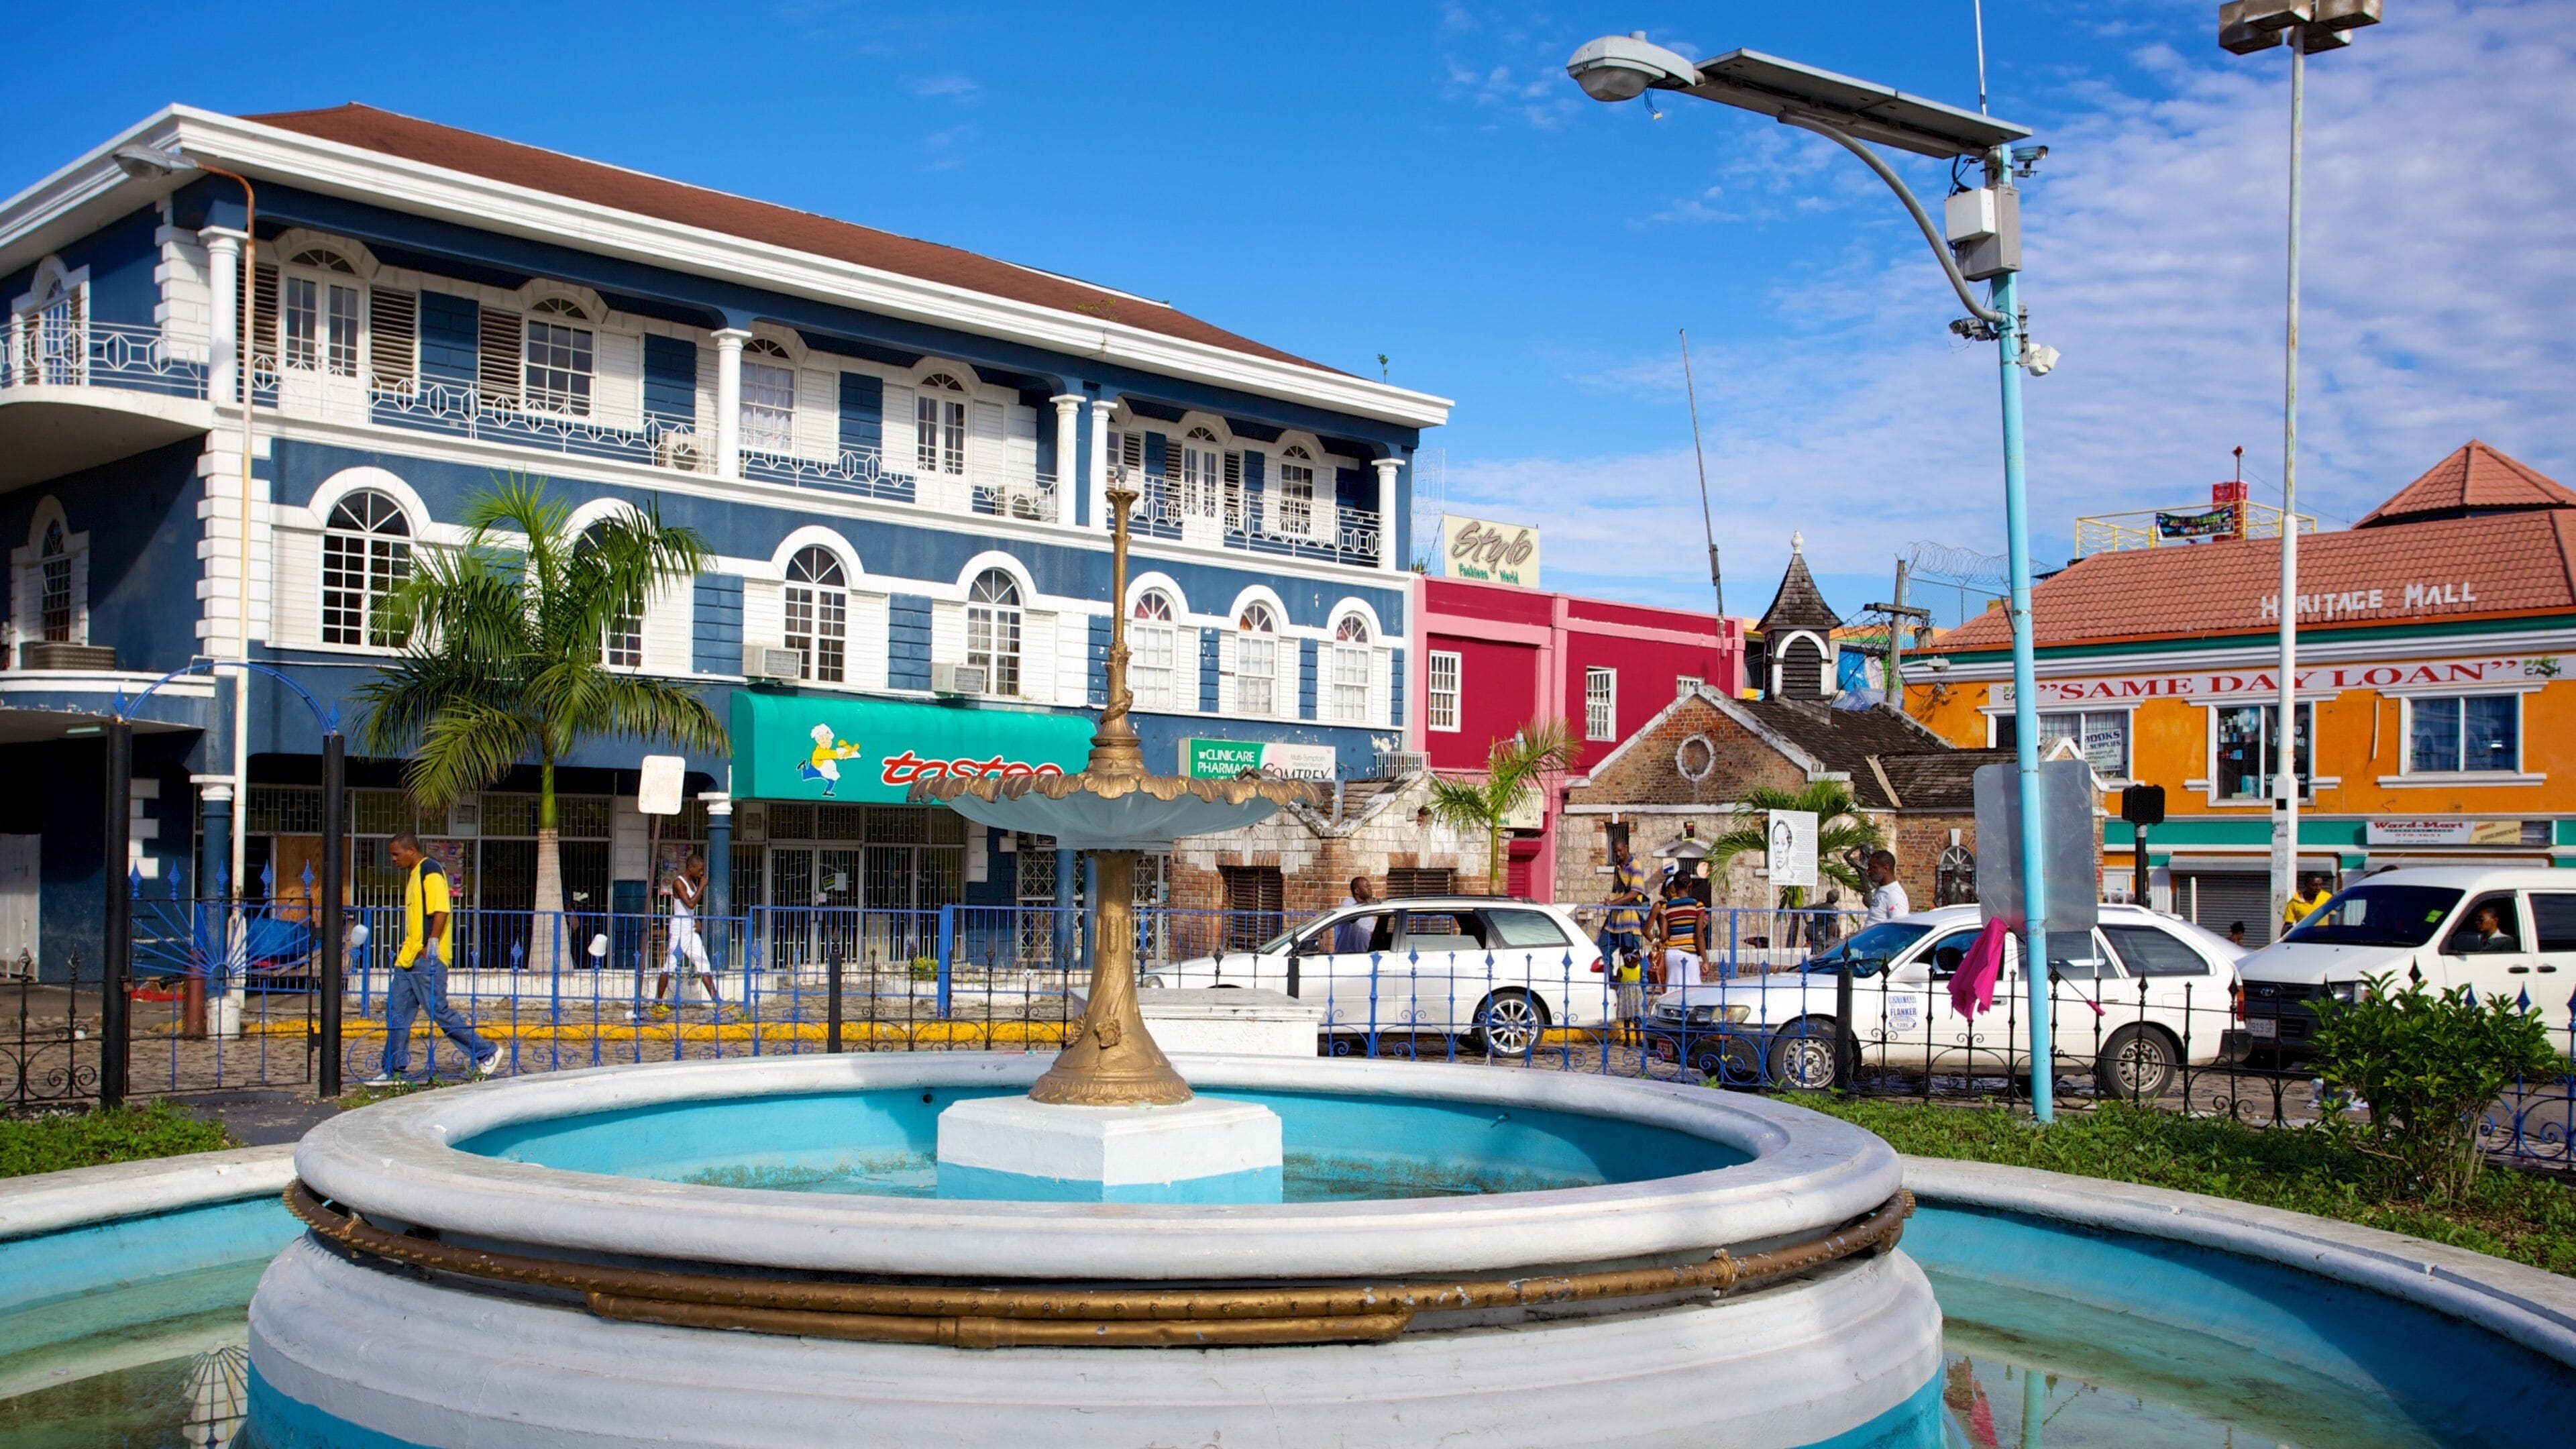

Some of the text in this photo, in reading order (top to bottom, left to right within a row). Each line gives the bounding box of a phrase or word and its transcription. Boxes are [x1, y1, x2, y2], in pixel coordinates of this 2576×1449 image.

[1450, 520, 1534, 575] Stylo
[1499, 568, 1519, 585] World
[2261, 582, 2477, 619] HRITAGE MALL
[2207, 672, 2317, 693] DAY
[1206, 749, 1255, 762] CLINICARE
[1890, 1008, 1917, 1016] FLANKER
